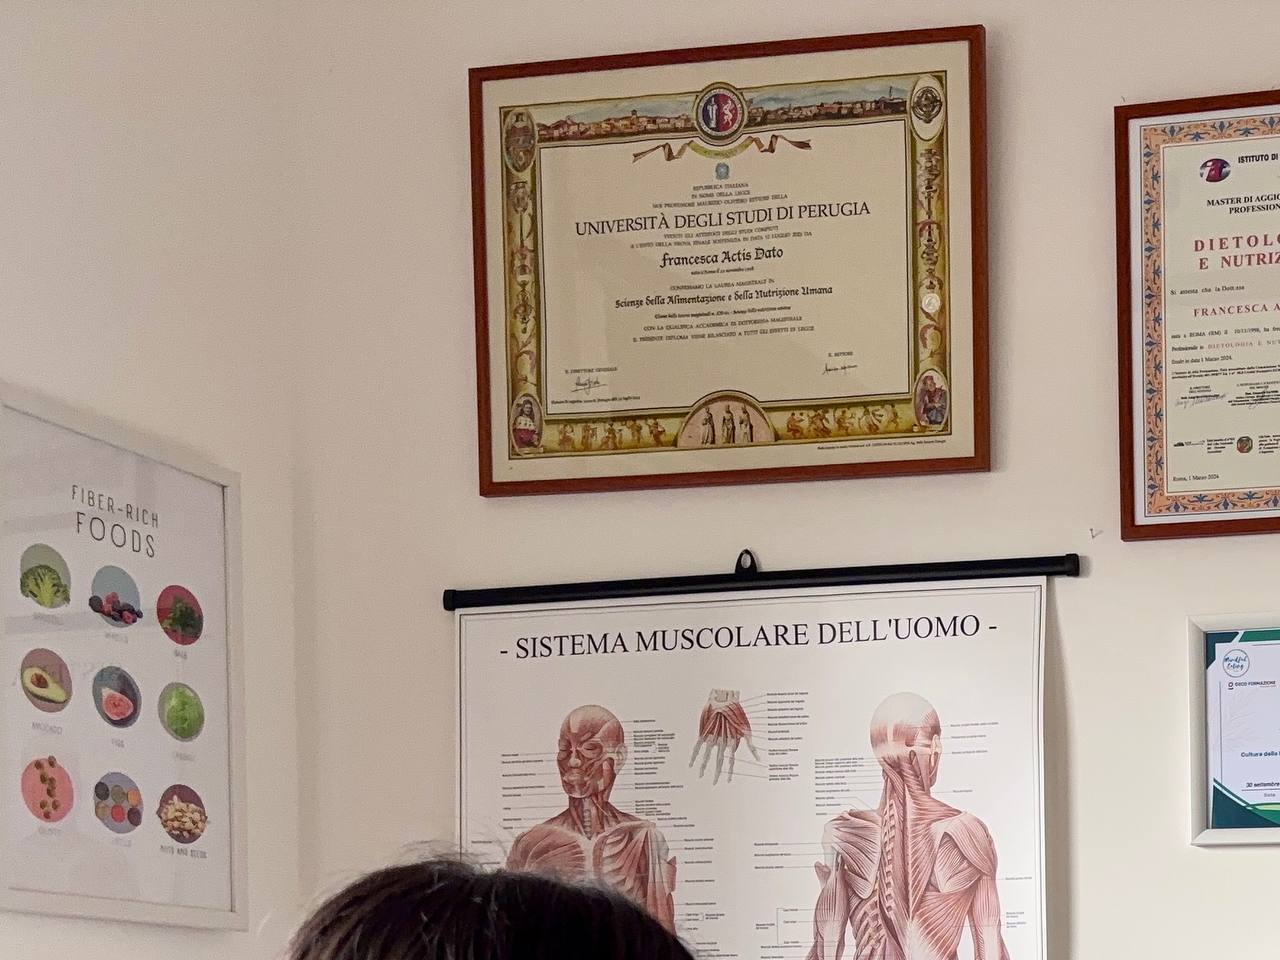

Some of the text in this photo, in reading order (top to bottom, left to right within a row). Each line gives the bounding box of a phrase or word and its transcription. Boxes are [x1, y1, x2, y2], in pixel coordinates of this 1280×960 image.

[1238, 153, 1270, 163] ISTITUTO
[1271, 152, 1279, 161] DI
[1206, 197, 1242, 207] MASTER
[1243, 196, 1253, 205] DI
[575, 201, 871, 236] UNIVERSITÀ DEGLI STUDI DI PERUGIA
[660, 246, 784, 268] Francesca Actis Dato
[1199, 257, 1209, 270] E
[615, 297, 643, 308] Scienze
[645, 295, 666, 306] della
[667, 293, 726, 305] Alimentazione
[734, 290, 754, 301] della
[755, 287, 800, 299] Nutrizione
[801, 286, 833, 296] Umana
[1193, 303, 1268, 317] FRANCESCA
[72, 484, 158, 529] FIBER-RICH
[77, 511, 155, 558] FOODS
[516, 614, 981, 659] SISTEMA MUSCOLARE DELL'UOMO
